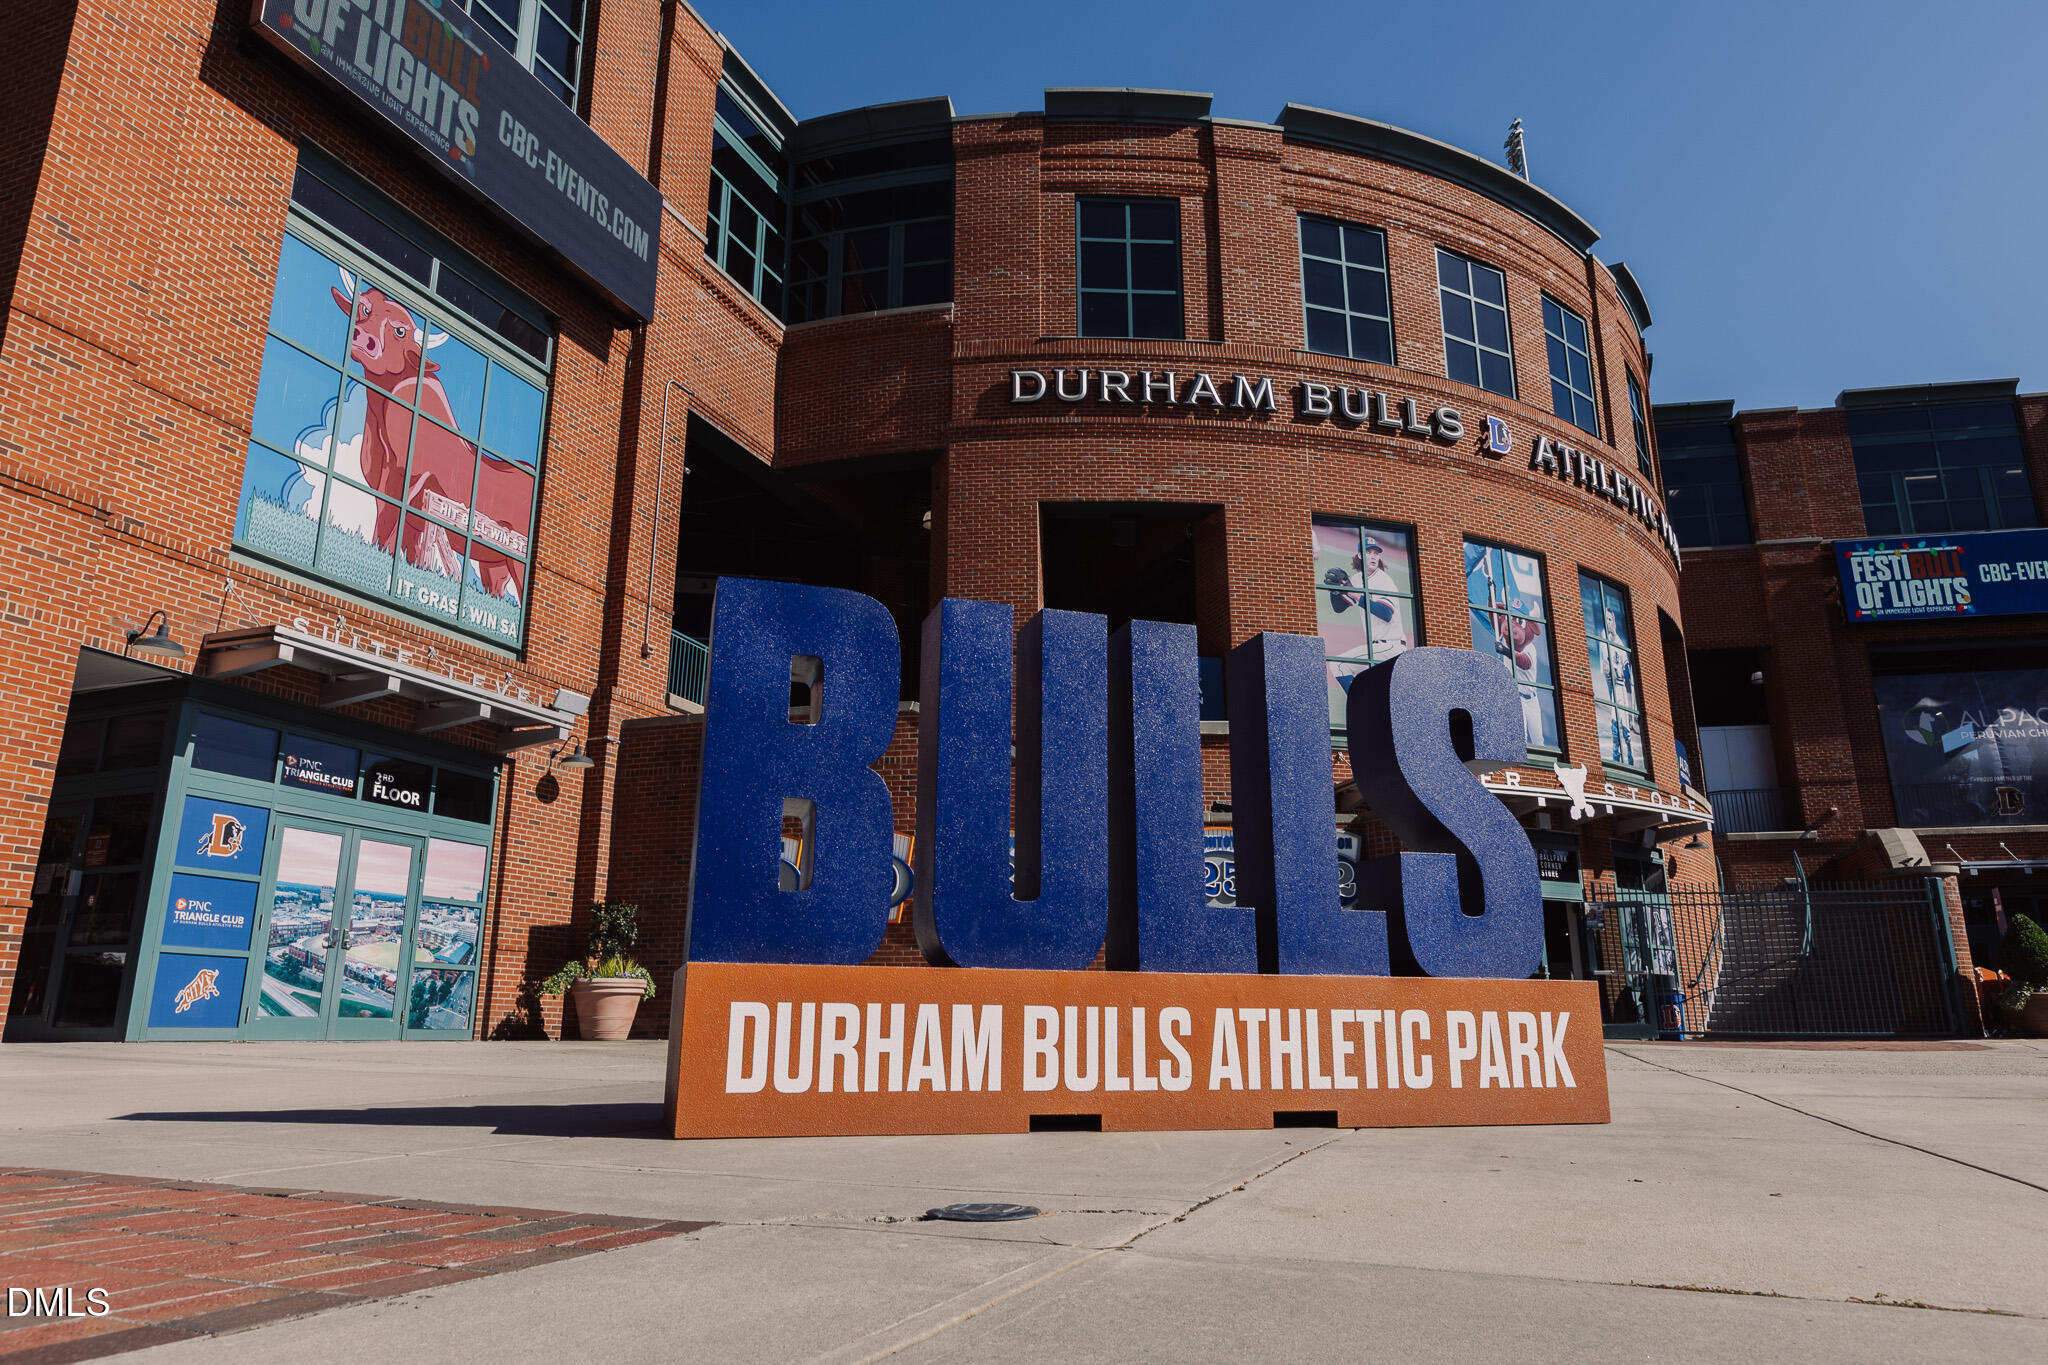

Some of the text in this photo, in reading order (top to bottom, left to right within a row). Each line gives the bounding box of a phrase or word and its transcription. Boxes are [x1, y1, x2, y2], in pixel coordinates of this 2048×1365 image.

[354, 14, 479, 155] LIGHTS
[500, 110, 648, 262] CBC-EVENTS.COM
[1011, 368, 1278, 414] DURHAM
[1301, 380, 1465, 442] BULLS
[1535, 435, 1658, 530] ATHLETIC
[462, 512, 489, 536] BLL
[489, 526, 511, 547] WIN
[1850, 551, 1967, 583] FESTIBULL
[418, 586, 466, 619] GRAS
[470, 605, 498, 630] WIN
[1855, 577, 1971, 609] OF LIGHTS
[1960, 729, 2027, 741] PERUVIAN
[284, 766, 331, 784] TRIANGLE
[331, 776, 354, 789] CLUB
[299, 757, 323, 771] PNC
[374, 772, 395, 785] 3RD
[688, 576, 1544, 979] BULLS
[373, 784, 420, 806] FLOOR
[1604, 784, 1697, 812] STORE
[1541, 869, 1559, 878] STORE
[174, 911, 245, 925] TRIANGLE CLUB
[188, 899, 212, 912] PNC
[726, 1000, 1578, 1095] DURHAM BULLS ATHLETIC PARK
